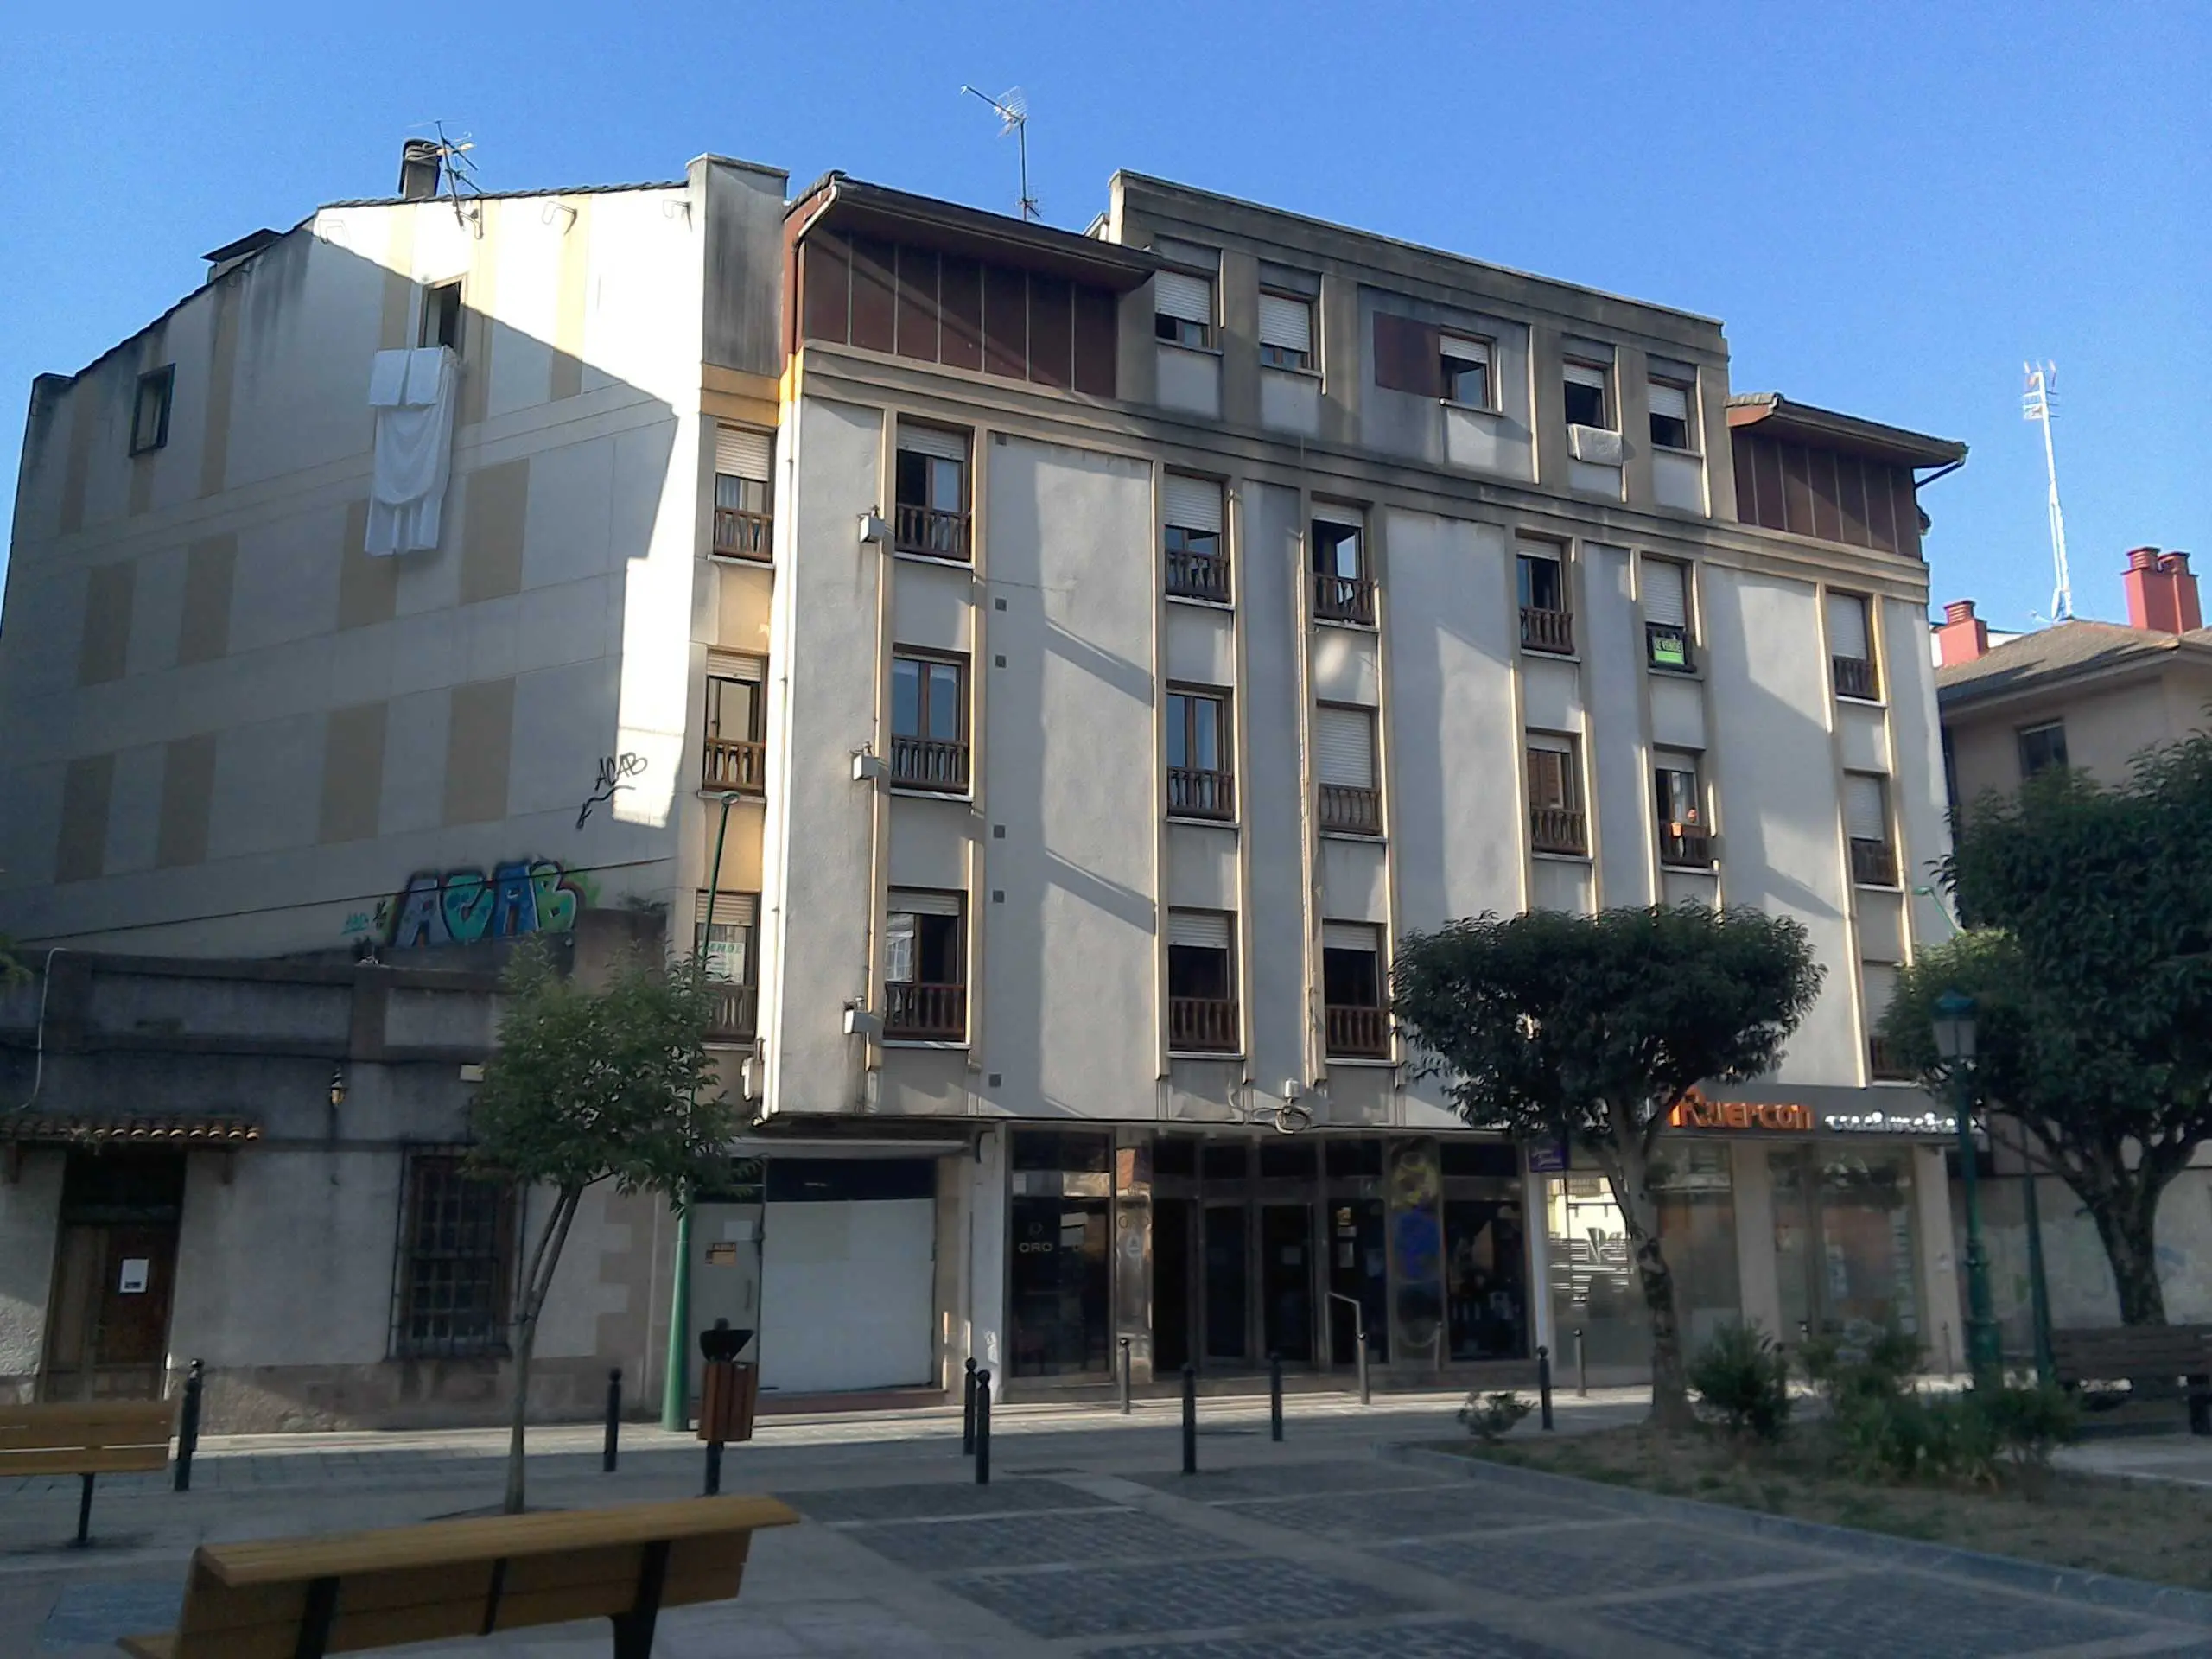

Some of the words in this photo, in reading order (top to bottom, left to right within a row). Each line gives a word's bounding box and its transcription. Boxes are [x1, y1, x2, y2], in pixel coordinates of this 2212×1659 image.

[594, 752, 648, 791] ACAB
[392, 859, 586, 949] ACAB
[1018, 1241, 1053, 1254] ORO
